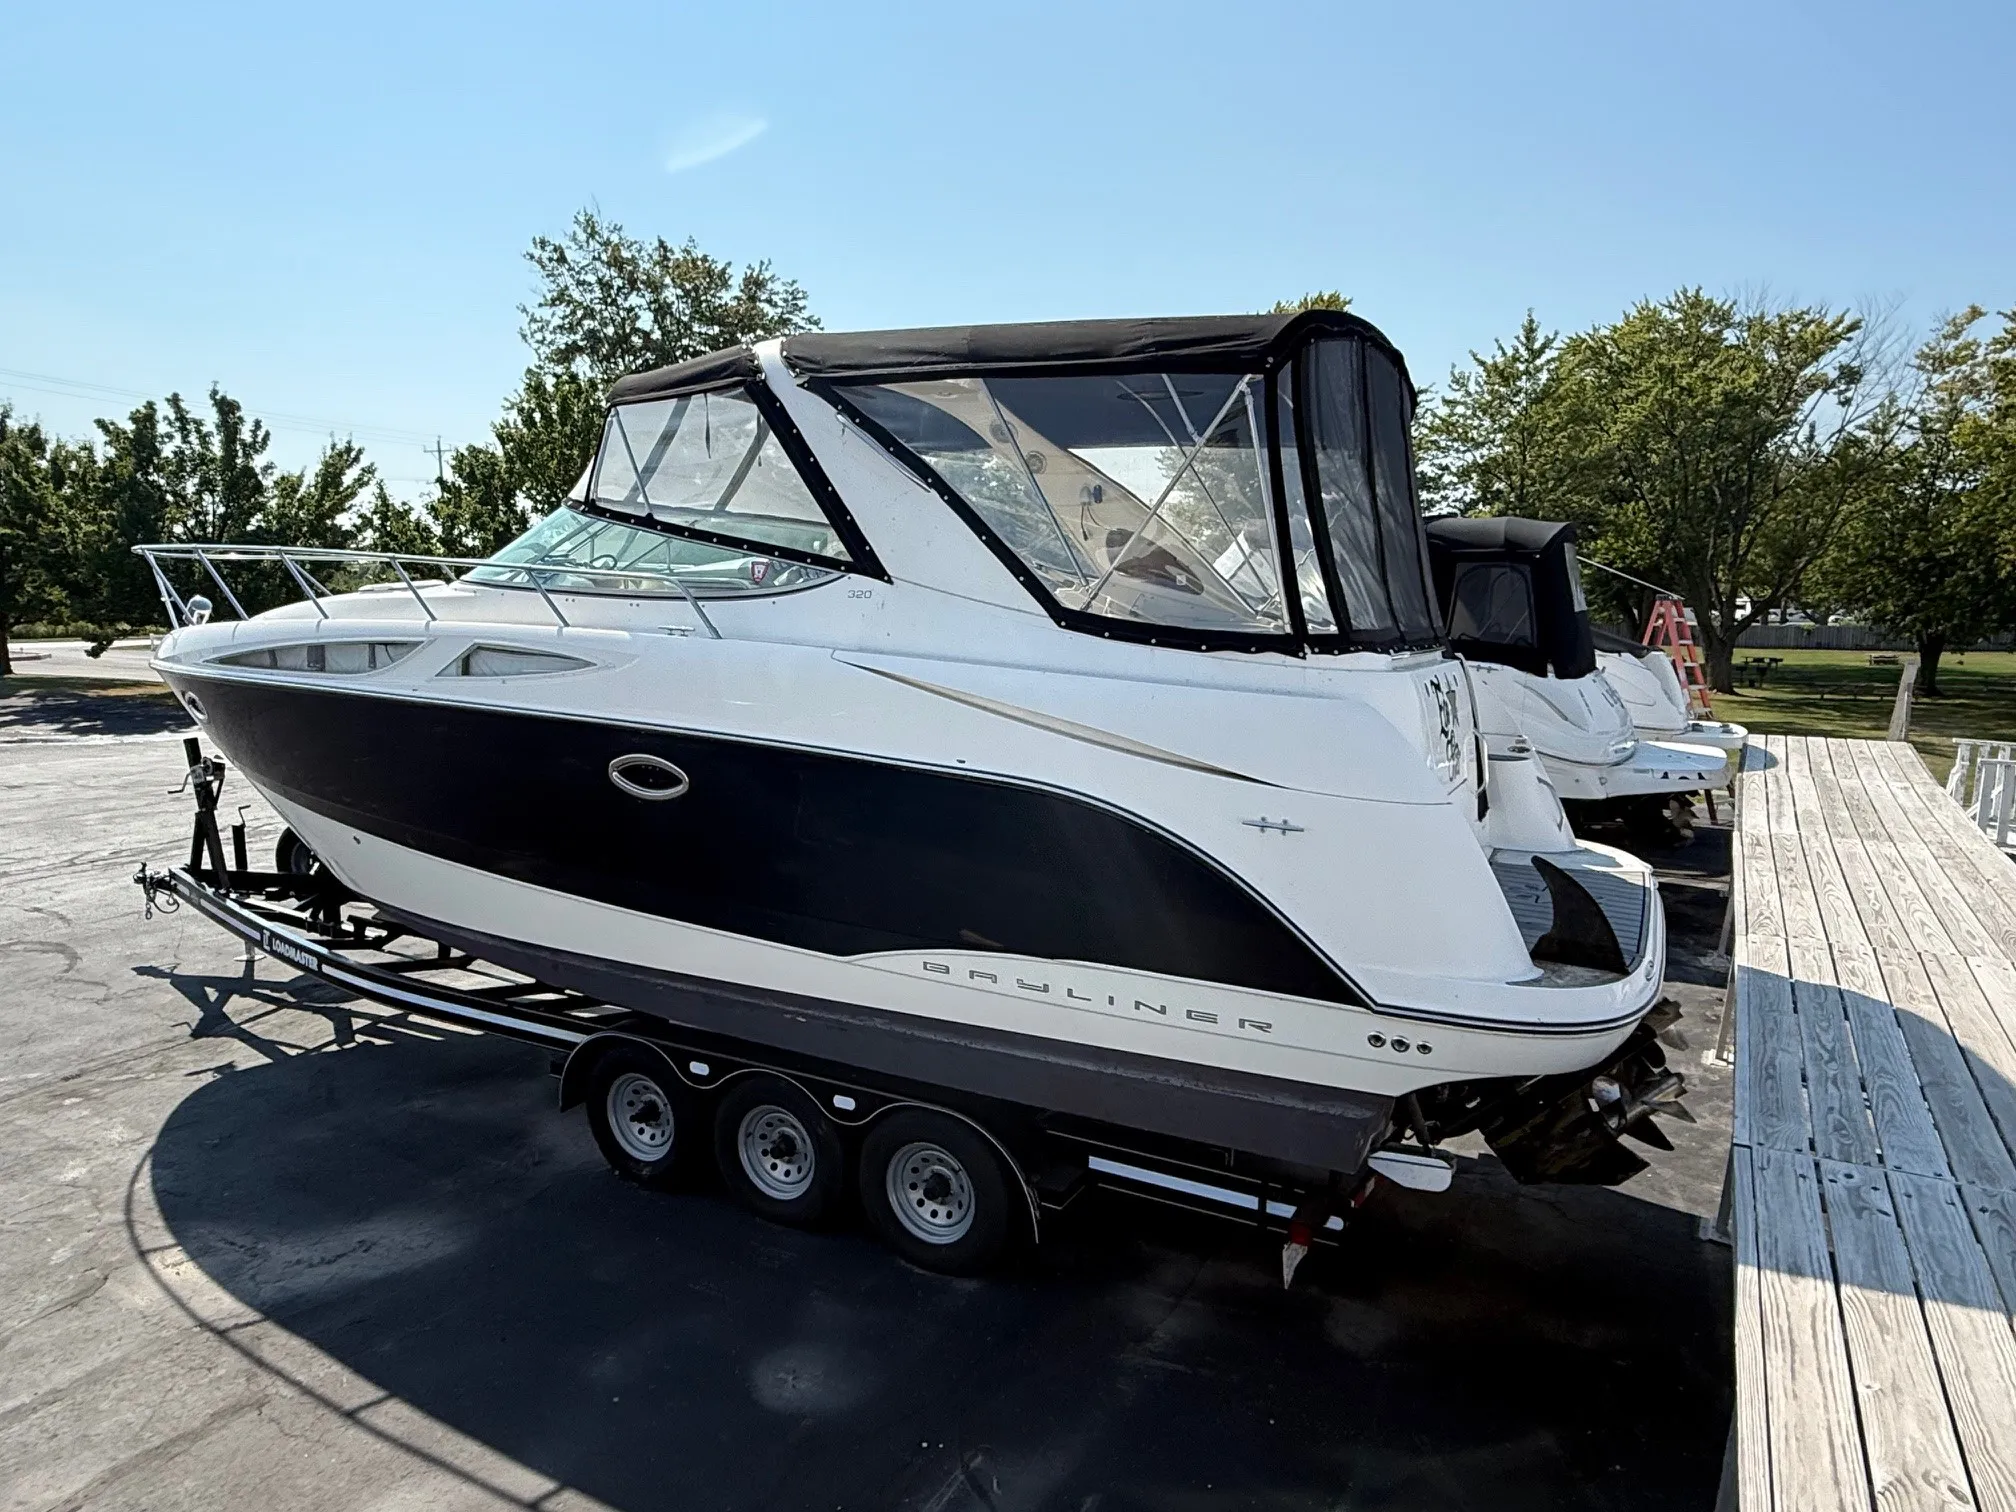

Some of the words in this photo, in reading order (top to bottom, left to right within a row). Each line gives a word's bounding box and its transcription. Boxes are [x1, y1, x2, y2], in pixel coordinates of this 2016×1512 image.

[847, 590, 873, 599] 320
[272, 937, 319, 972] LOADMASTER
[922, 960, 1273, 1034] BAYLINER
